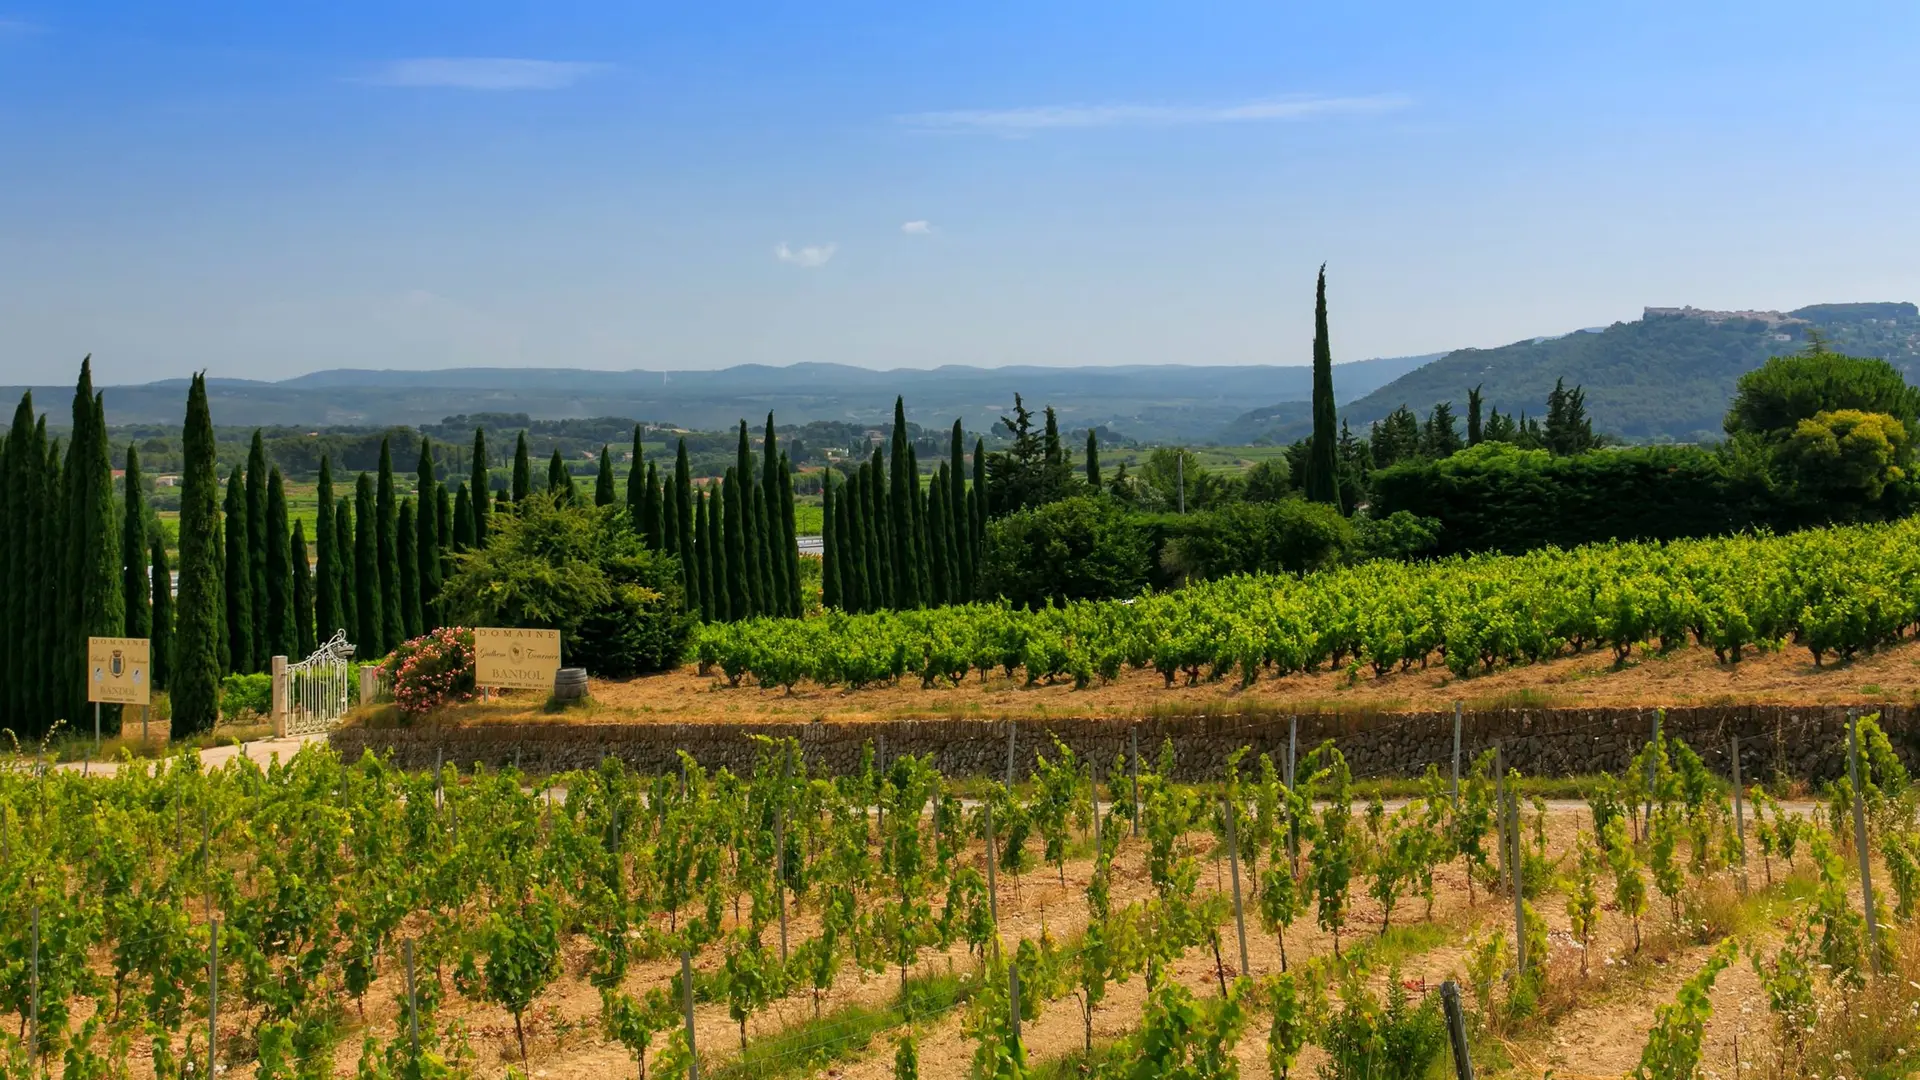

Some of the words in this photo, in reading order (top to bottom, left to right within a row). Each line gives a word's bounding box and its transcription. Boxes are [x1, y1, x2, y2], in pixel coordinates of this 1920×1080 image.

[480, 630, 555, 639] DOMAINE
[92, 639, 148, 647] DOMAINE
[492, 669, 545, 680] BANDOL
[100, 686, 138, 697] BANDOL
